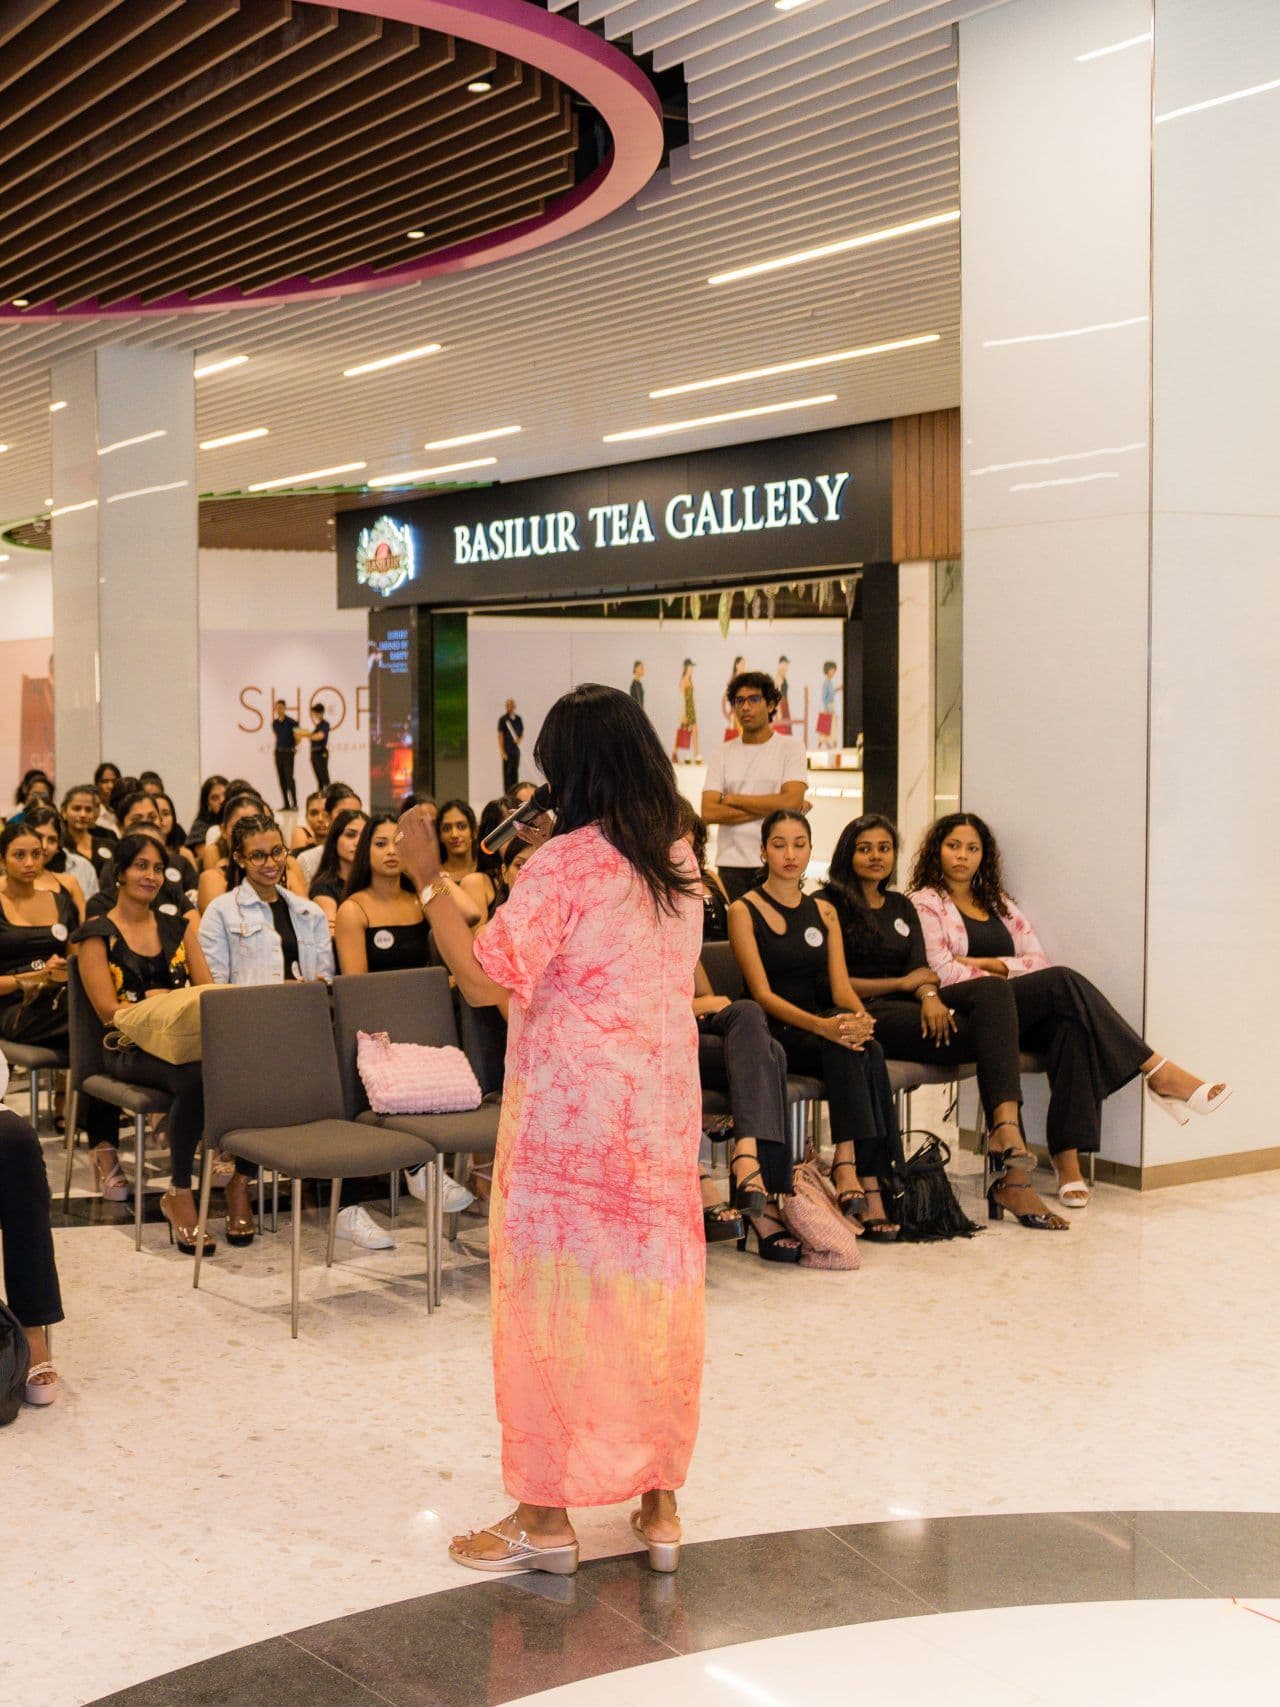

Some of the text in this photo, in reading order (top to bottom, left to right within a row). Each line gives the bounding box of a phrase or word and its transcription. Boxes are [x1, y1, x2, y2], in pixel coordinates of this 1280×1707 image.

[454, 472, 850, 565] BASILUR TEA GALLERY
